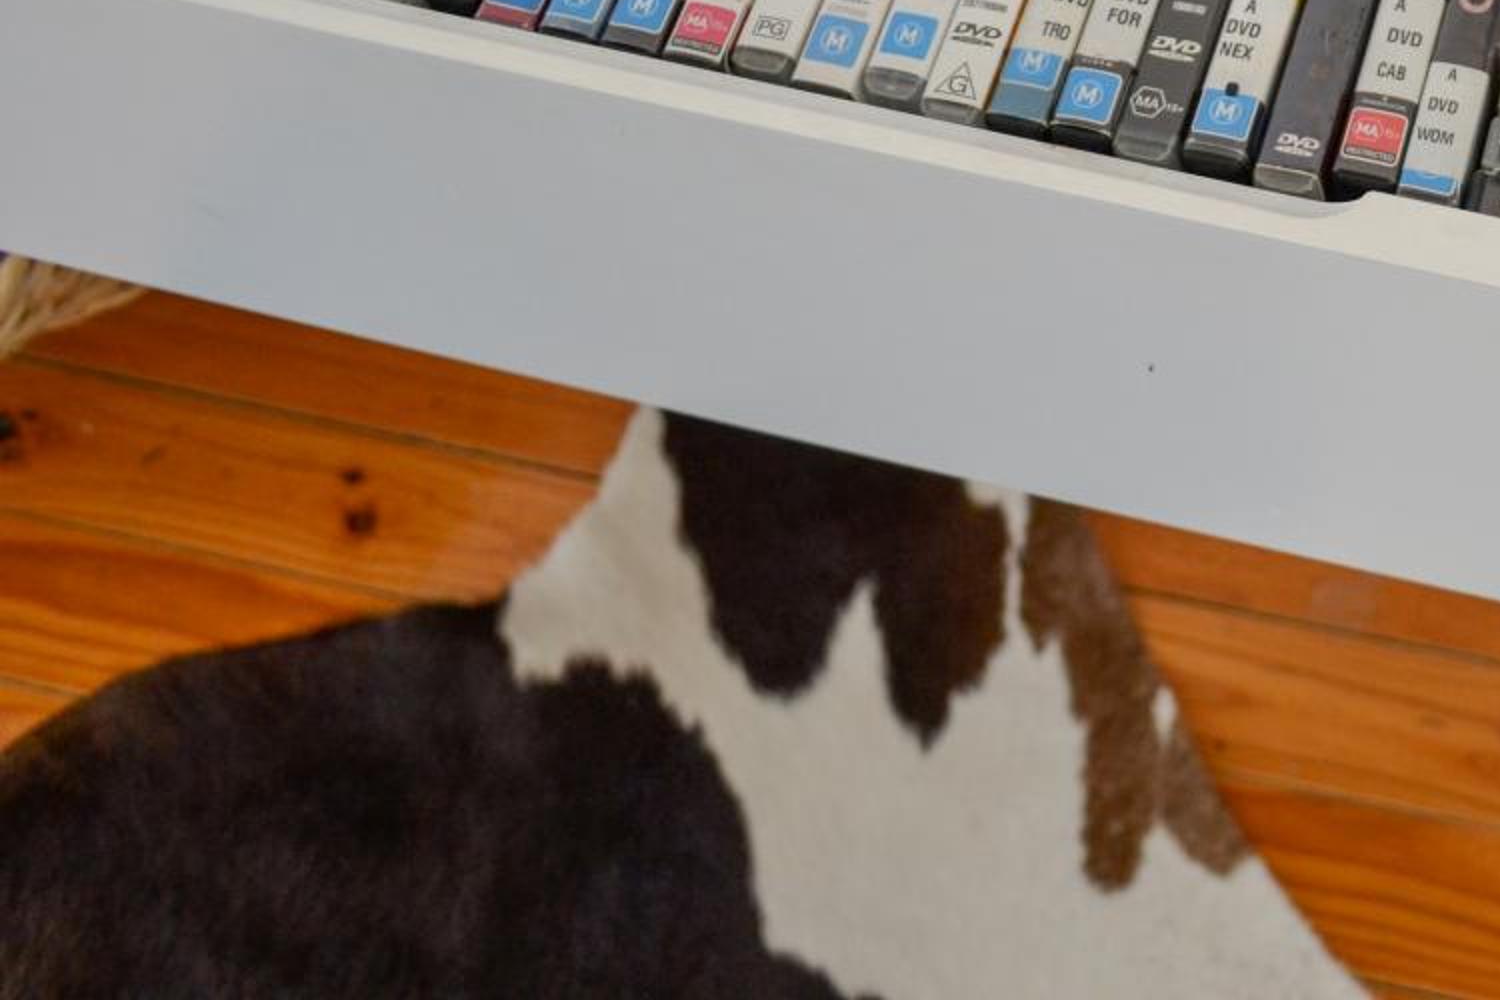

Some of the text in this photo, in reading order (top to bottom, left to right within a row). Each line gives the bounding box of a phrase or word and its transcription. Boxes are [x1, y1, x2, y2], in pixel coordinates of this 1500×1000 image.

[953, 21, 1002, 41] DVD
[1040, 20, 1071, 41] TRO
[1107, 8, 1142, 28] FOR
[1218, 19, 1262, 61] DVD NEX
[1377, 27, 1423, 81] DVD CAB
[1416, 97, 1459, 146] DVD WOM
